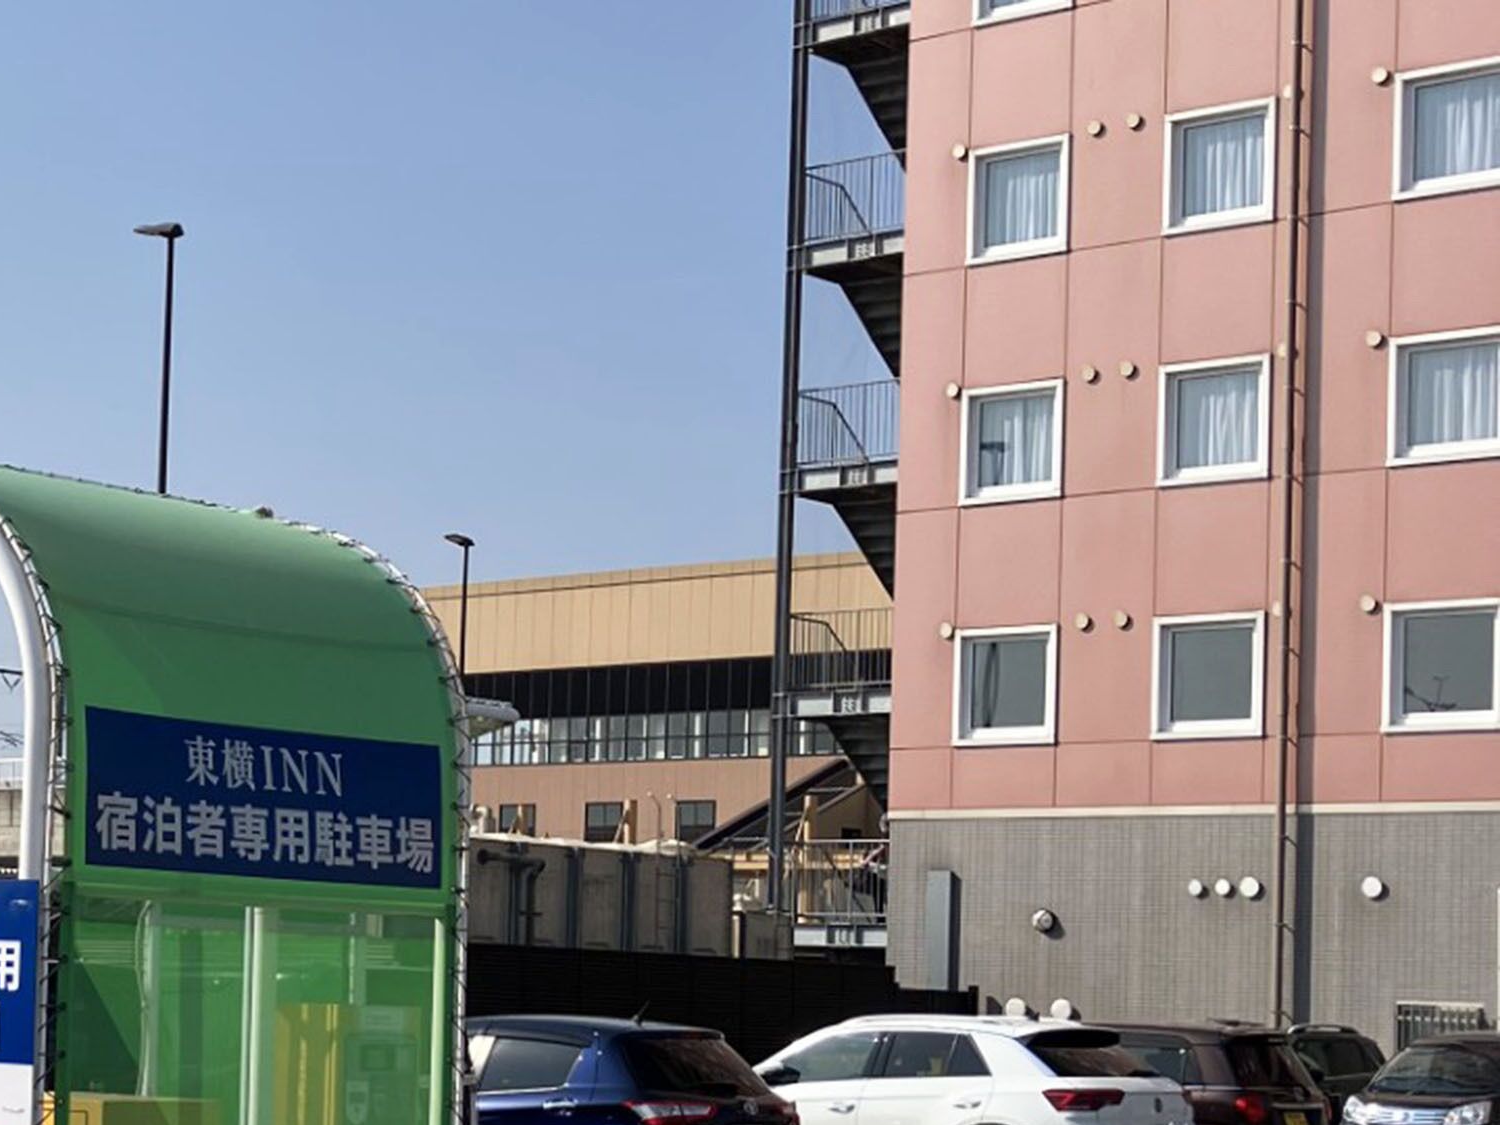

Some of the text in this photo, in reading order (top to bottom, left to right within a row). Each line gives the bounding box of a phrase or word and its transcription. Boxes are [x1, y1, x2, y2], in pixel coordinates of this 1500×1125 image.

[184, 736, 342, 797] 東横INN
[95, 792, 434, 873] 宿泊者専用駐車場
